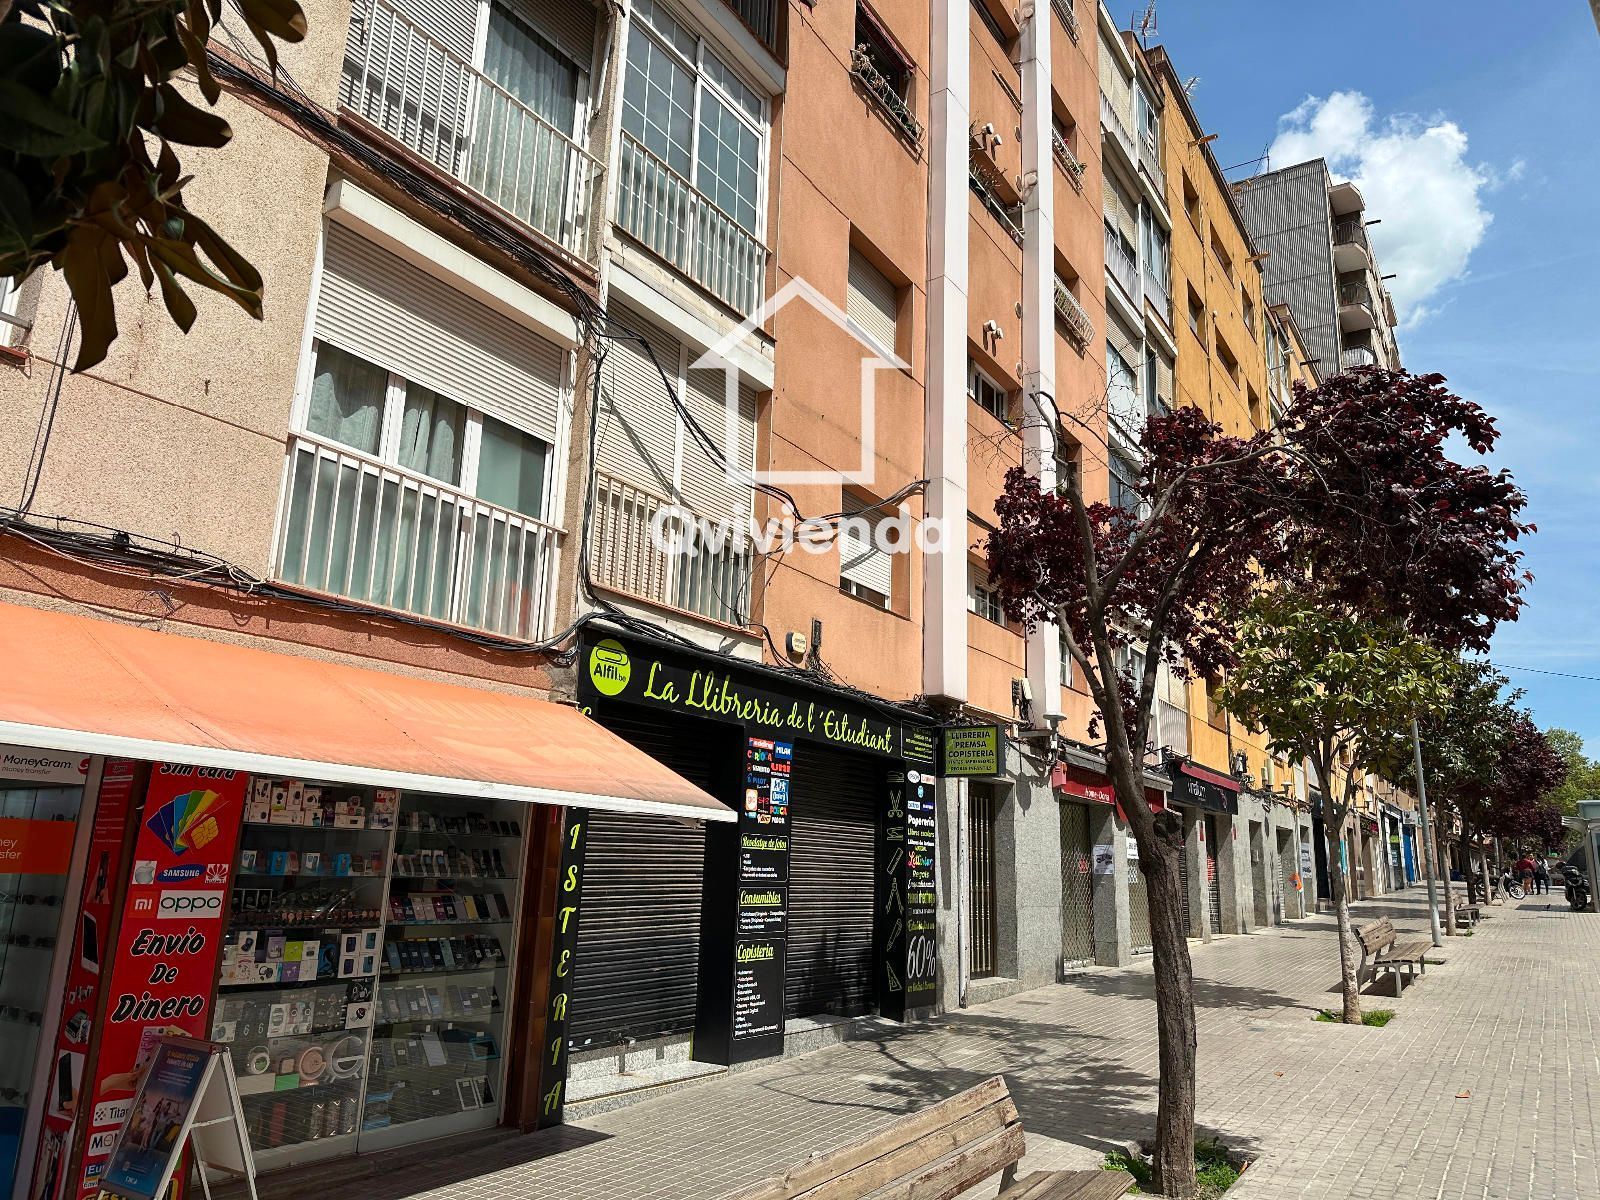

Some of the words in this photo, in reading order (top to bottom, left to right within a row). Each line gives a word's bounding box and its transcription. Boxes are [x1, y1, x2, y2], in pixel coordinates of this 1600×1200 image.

[643, 660, 680, 703] La
[685, 669, 784, 728] Llibreria
[786, 701, 804, 729] de
[951, 731, 990, 740] LLIBRERIA
[955, 740, 987, 748] PREMSA
[4, 754, 71, 769] MoneyGram
[948, 750, 994, 758] COPISTERIA
[163, 869, 200, 878] SAMSUNG
[740, 890, 781, 904] Consumibles
[130, 926, 205, 956] Envio
[738, 944, 773, 963] Copisteria
[907, 935, 935, 979] 60%
[148, 963, 178, 985] De
[111, 991, 204, 1023] Dinero
